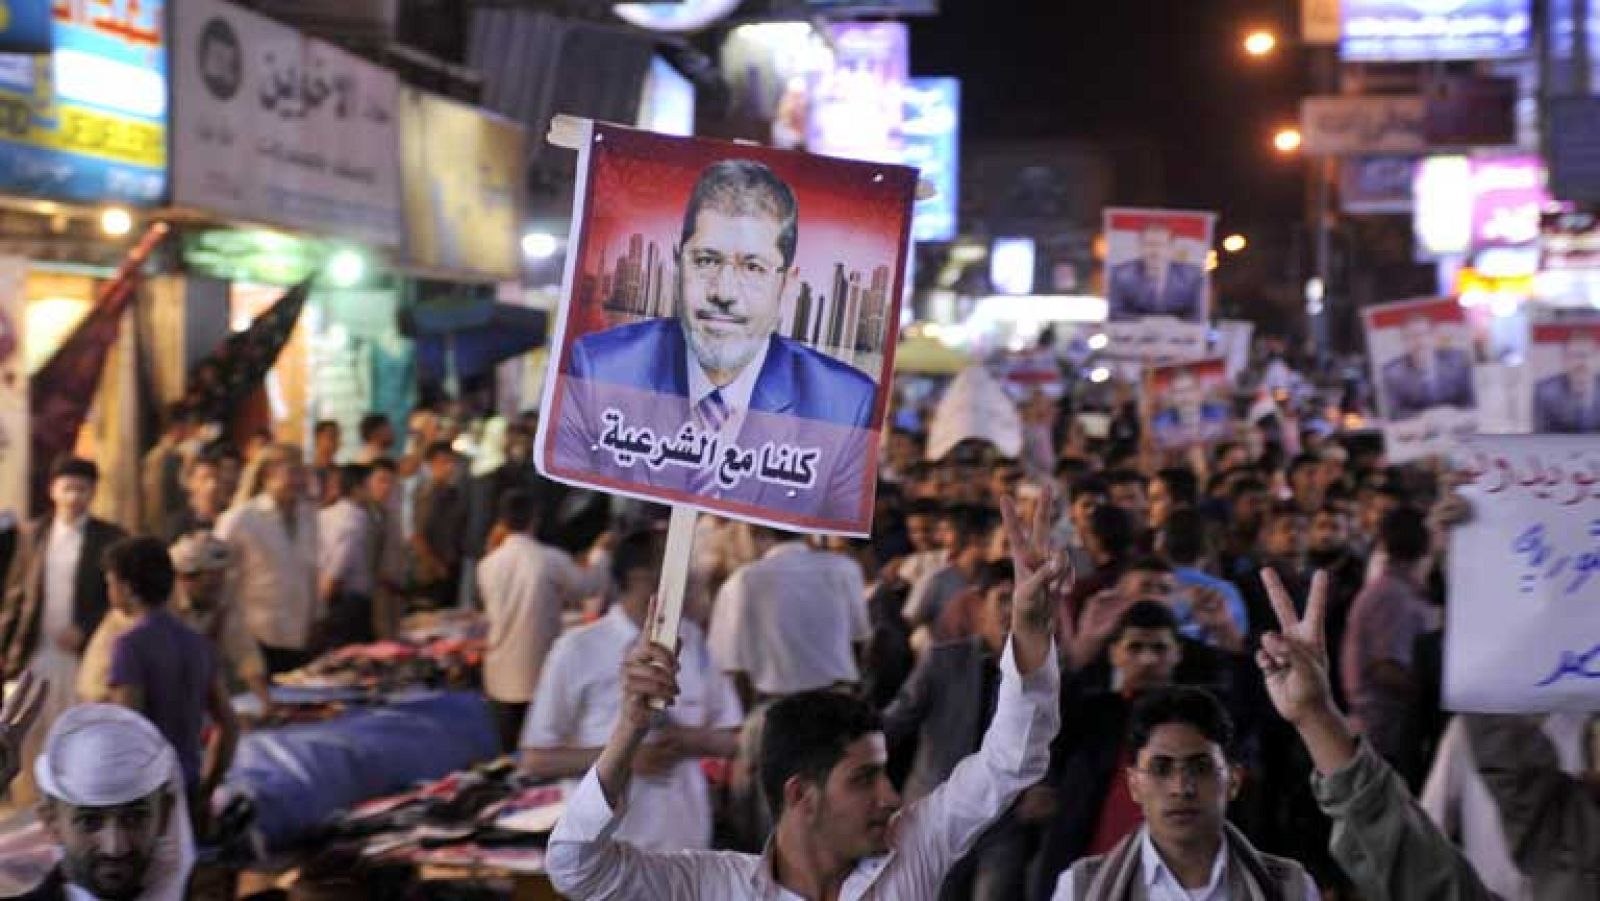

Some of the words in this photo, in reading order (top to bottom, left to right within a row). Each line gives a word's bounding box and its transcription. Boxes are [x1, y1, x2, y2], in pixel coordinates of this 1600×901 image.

[600, 408, 718, 468] الشرعية
[717, 446, 752, 486] مع
[760, 442, 818, 486] كلنا
